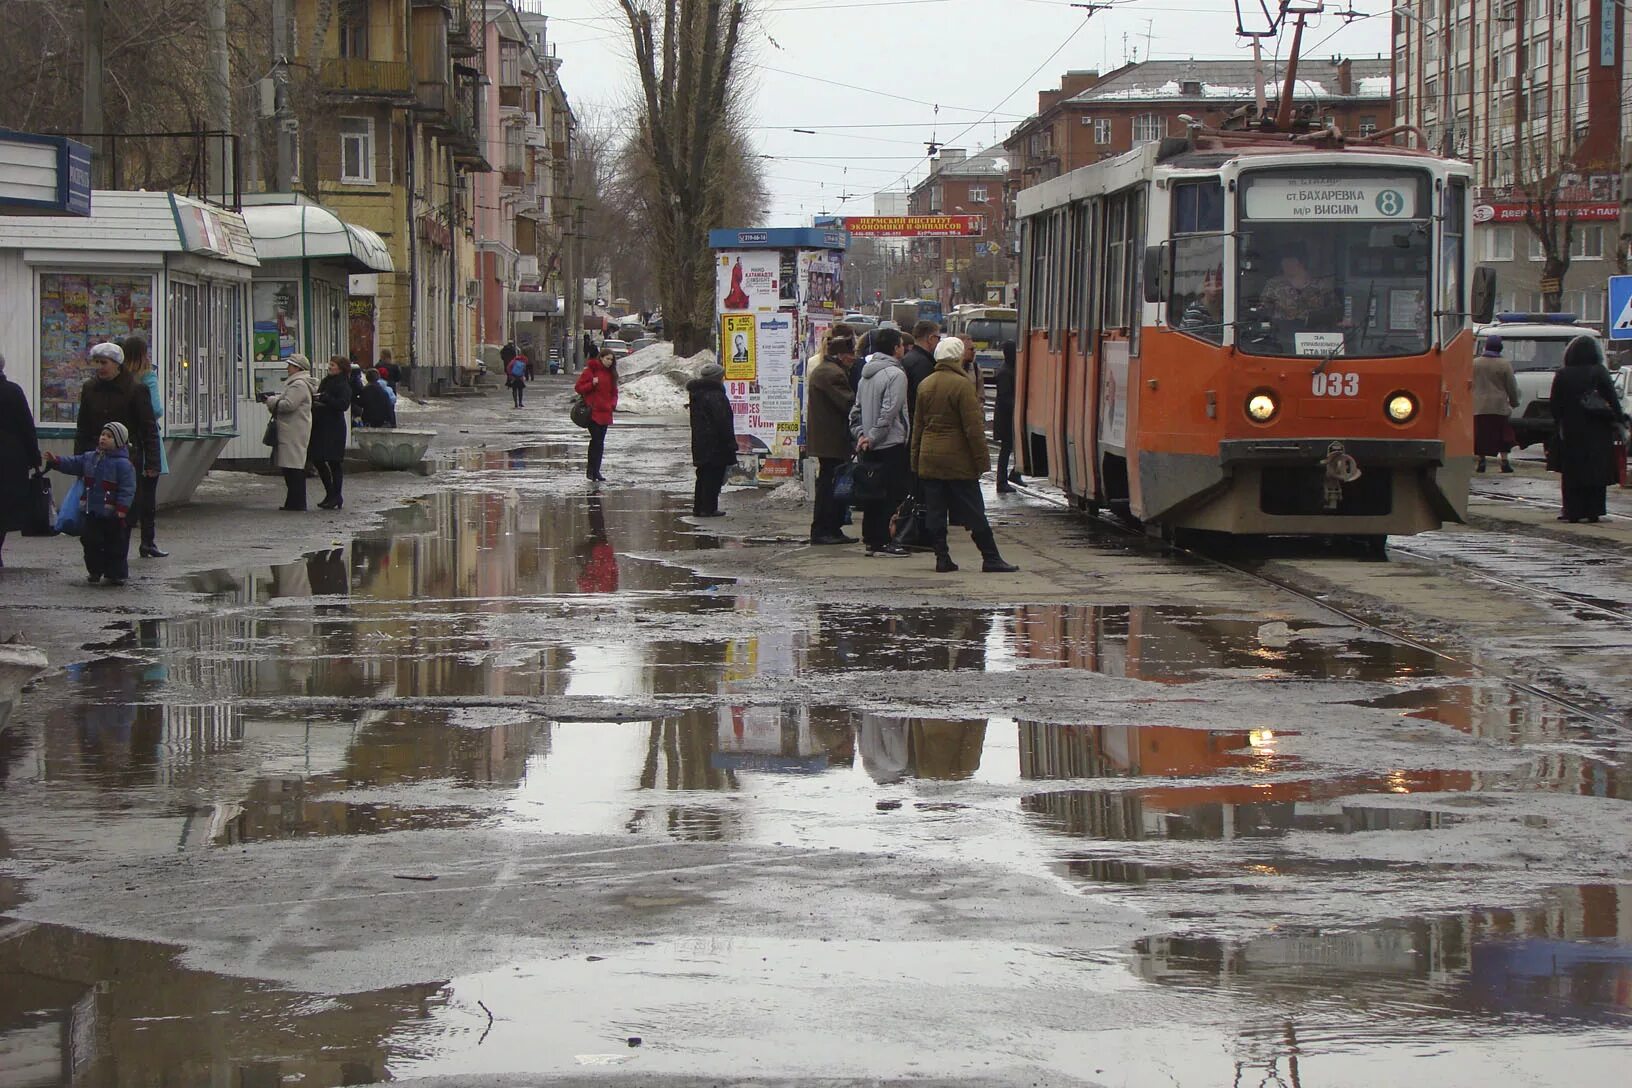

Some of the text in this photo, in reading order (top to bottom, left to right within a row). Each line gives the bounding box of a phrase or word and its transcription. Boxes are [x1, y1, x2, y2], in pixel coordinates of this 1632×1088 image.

[1604, 0, 1613, 56] ТЕКА
[1314, 204, 1358, 215] ВИСИМ
[1381, 191, 1397, 215] 8
[728, 318, 734, 331] 5
[1312, 372, 1359, 396] 033
